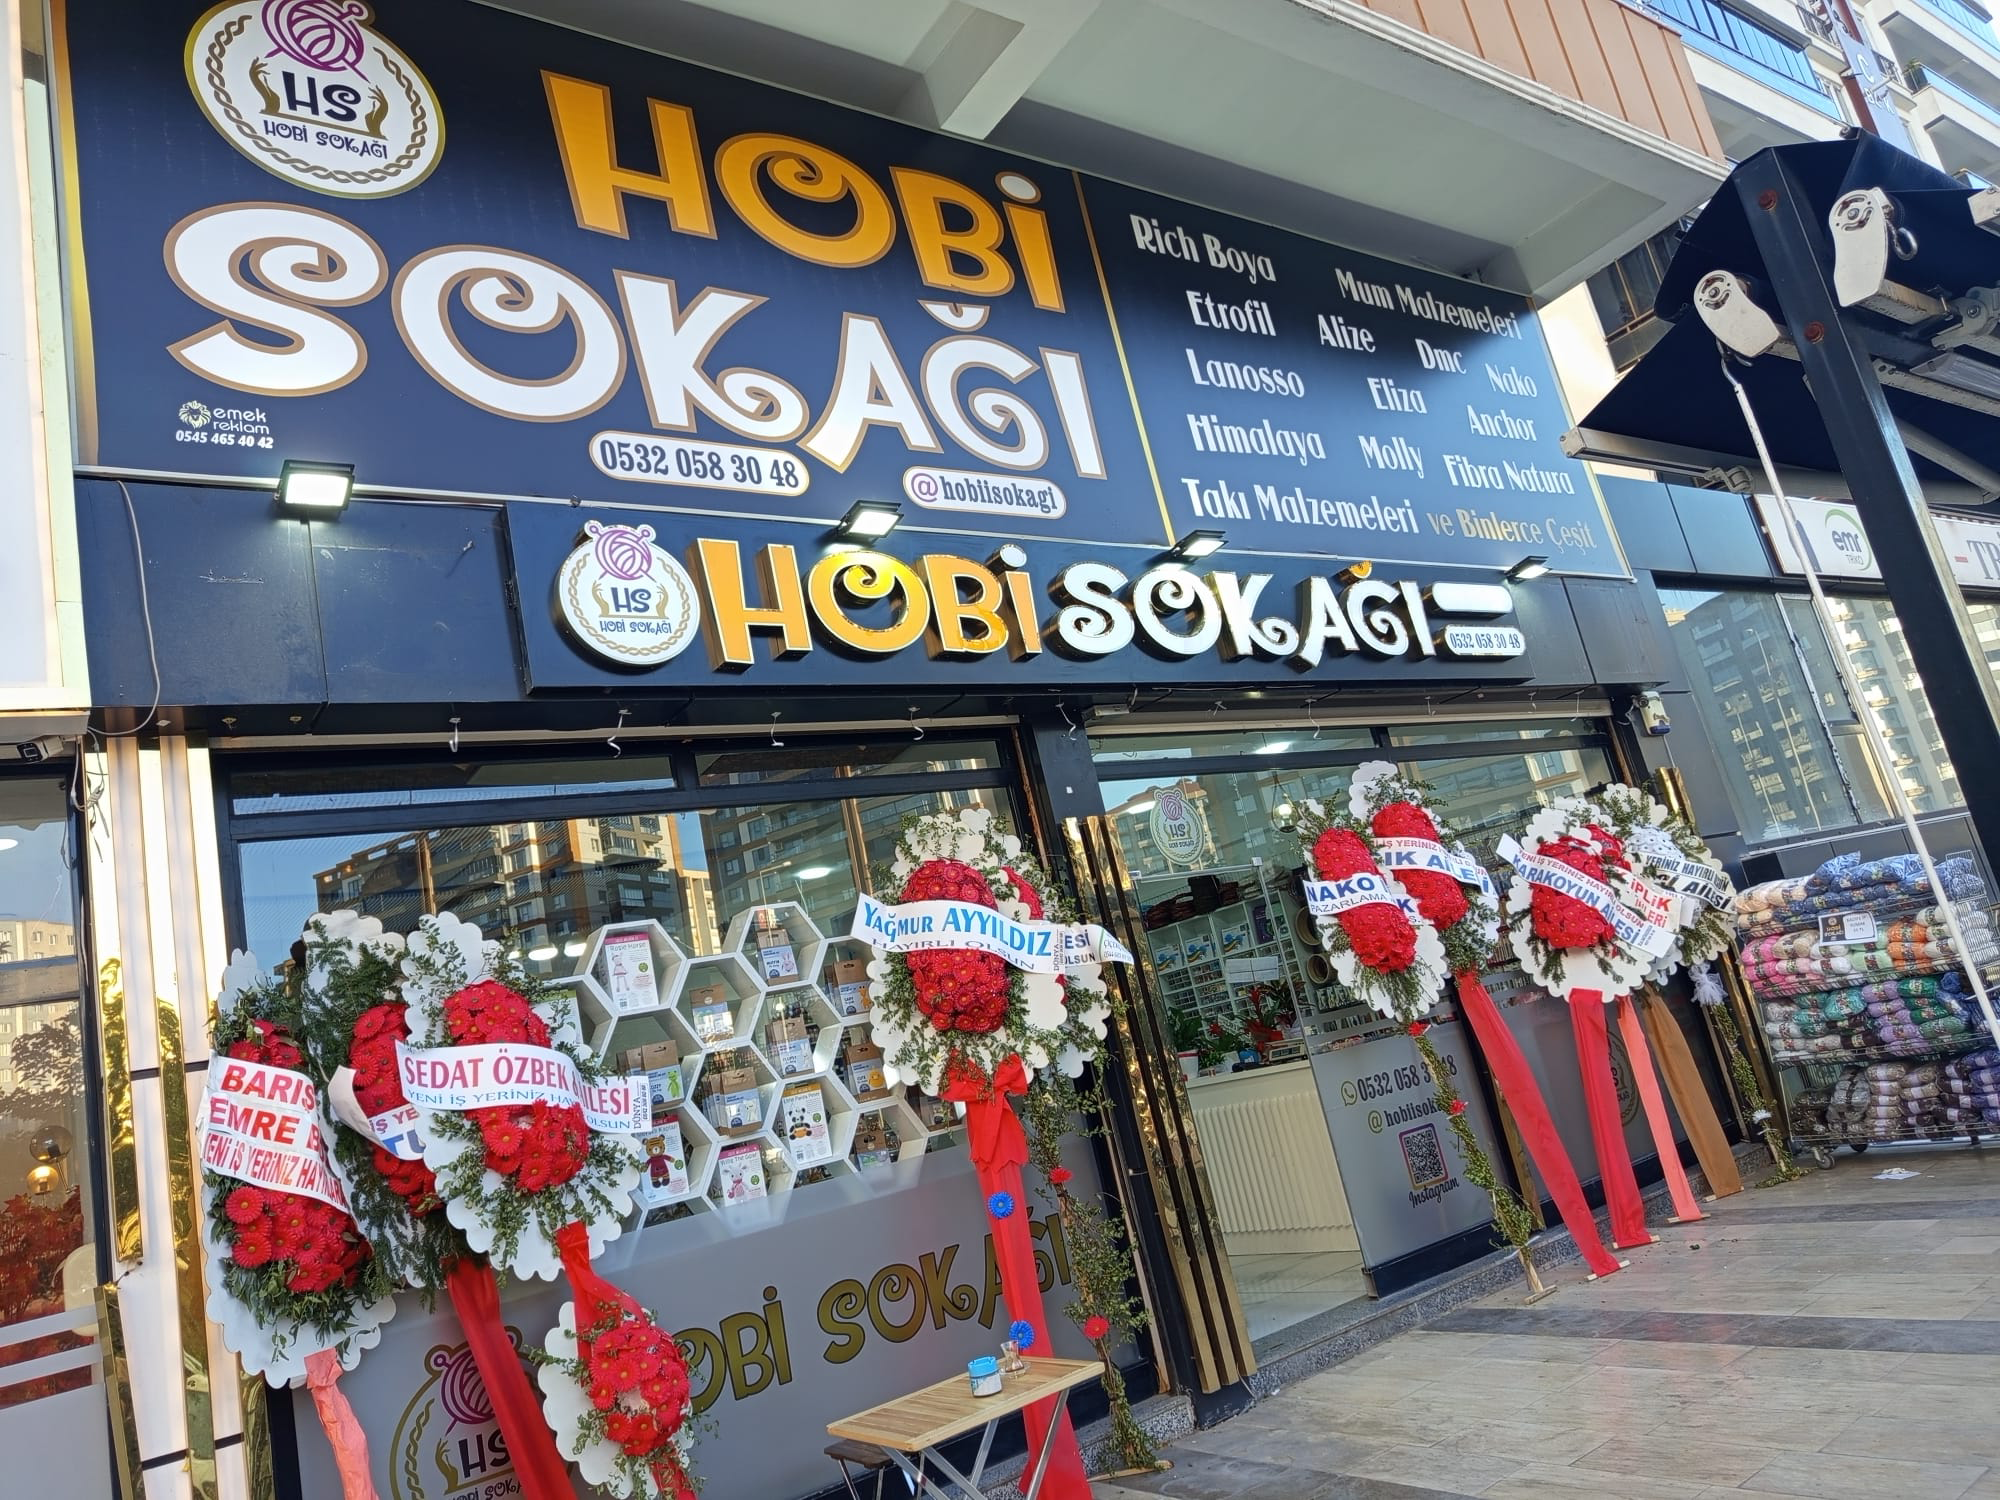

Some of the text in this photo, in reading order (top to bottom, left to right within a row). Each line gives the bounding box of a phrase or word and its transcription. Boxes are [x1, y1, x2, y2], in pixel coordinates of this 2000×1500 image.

[282, 71, 361, 121] HS
[264, 120, 387, 159] HOBİ SOKAĞI
[540, 69, 1065, 313] HOBİ
[1129, 214, 1276, 284] Rich Boya
[1335, 267, 1523, 341] Mum Malzemeleri
[163, 202, 1107, 480] SOKAĞI
[1186, 290, 1538, 399] Etrofil Alize Dmc Nako
[1186, 349, 1537, 442] Lanosso Eliza Anchor
[213, 408, 267, 423] emek
[213, 420, 270, 435] reklam
[176, 430, 274, 449] 0545 465 40 42
[1187, 414, 1575, 496] Himalaya Molly Fibra Natura
[600, 439, 799, 488] 0532 058 30 48
[910, 473, 1058, 513] @hobiisokagi
[1181, 478, 1598, 556] Takı Malzemeleri ve Binlerce Çeşit
[1832, 530, 1862, 552] emr
[611, 587, 651, 613] HS
[695, 538, 1437, 670] HOBİ SOKAĞI
[600, 619, 672, 635] HOBİ SOKAĞI
[1450, 633, 1520, 648] 0532 058 30 48
[1169, 824, 1186, 838] HS
[1384, 851, 1418, 866] IK
[1306, 877, 1375, 902] NAKO
[1513, 855, 1600, 907] KARAKOYUN
[1682, 881, 1732, 910] AİLESİ
[1310, 893, 1387, 912] PAZARLAMA
[1616, 906, 1645, 928] OLSUN
[872, 938, 955, 951] HAYIRLI
[942, 908, 1051, 957] AYYILDIZ
[1064, 929, 1090, 949] ESİ
[1064, 952, 1096, 965] LSUN
[405, 1056, 484, 1089] SEDAT
[492, 1048, 570, 1092] ÖZBEK
[1357, 1072, 1393, 1101] 0532
[1393, 1064, 1420, 1091] 058
[1421, 1062, 1432, 1083] 3
[407, 1089, 443, 1104] YENİ
[450, 1094, 467, 1106] İŞ
[473, 1088, 545, 1103] YERİNİZ
[632, 1096, 641, 1129] DÜNYA
[210, 1097, 300, 1145] EMRE
[245, 1146, 299, 1185] YERİNİZ
[1409, 1176, 1459, 1208] Instagram
[670, 1286, 793, 1415] OBİ
[458, 1428, 511, 1480] HS
